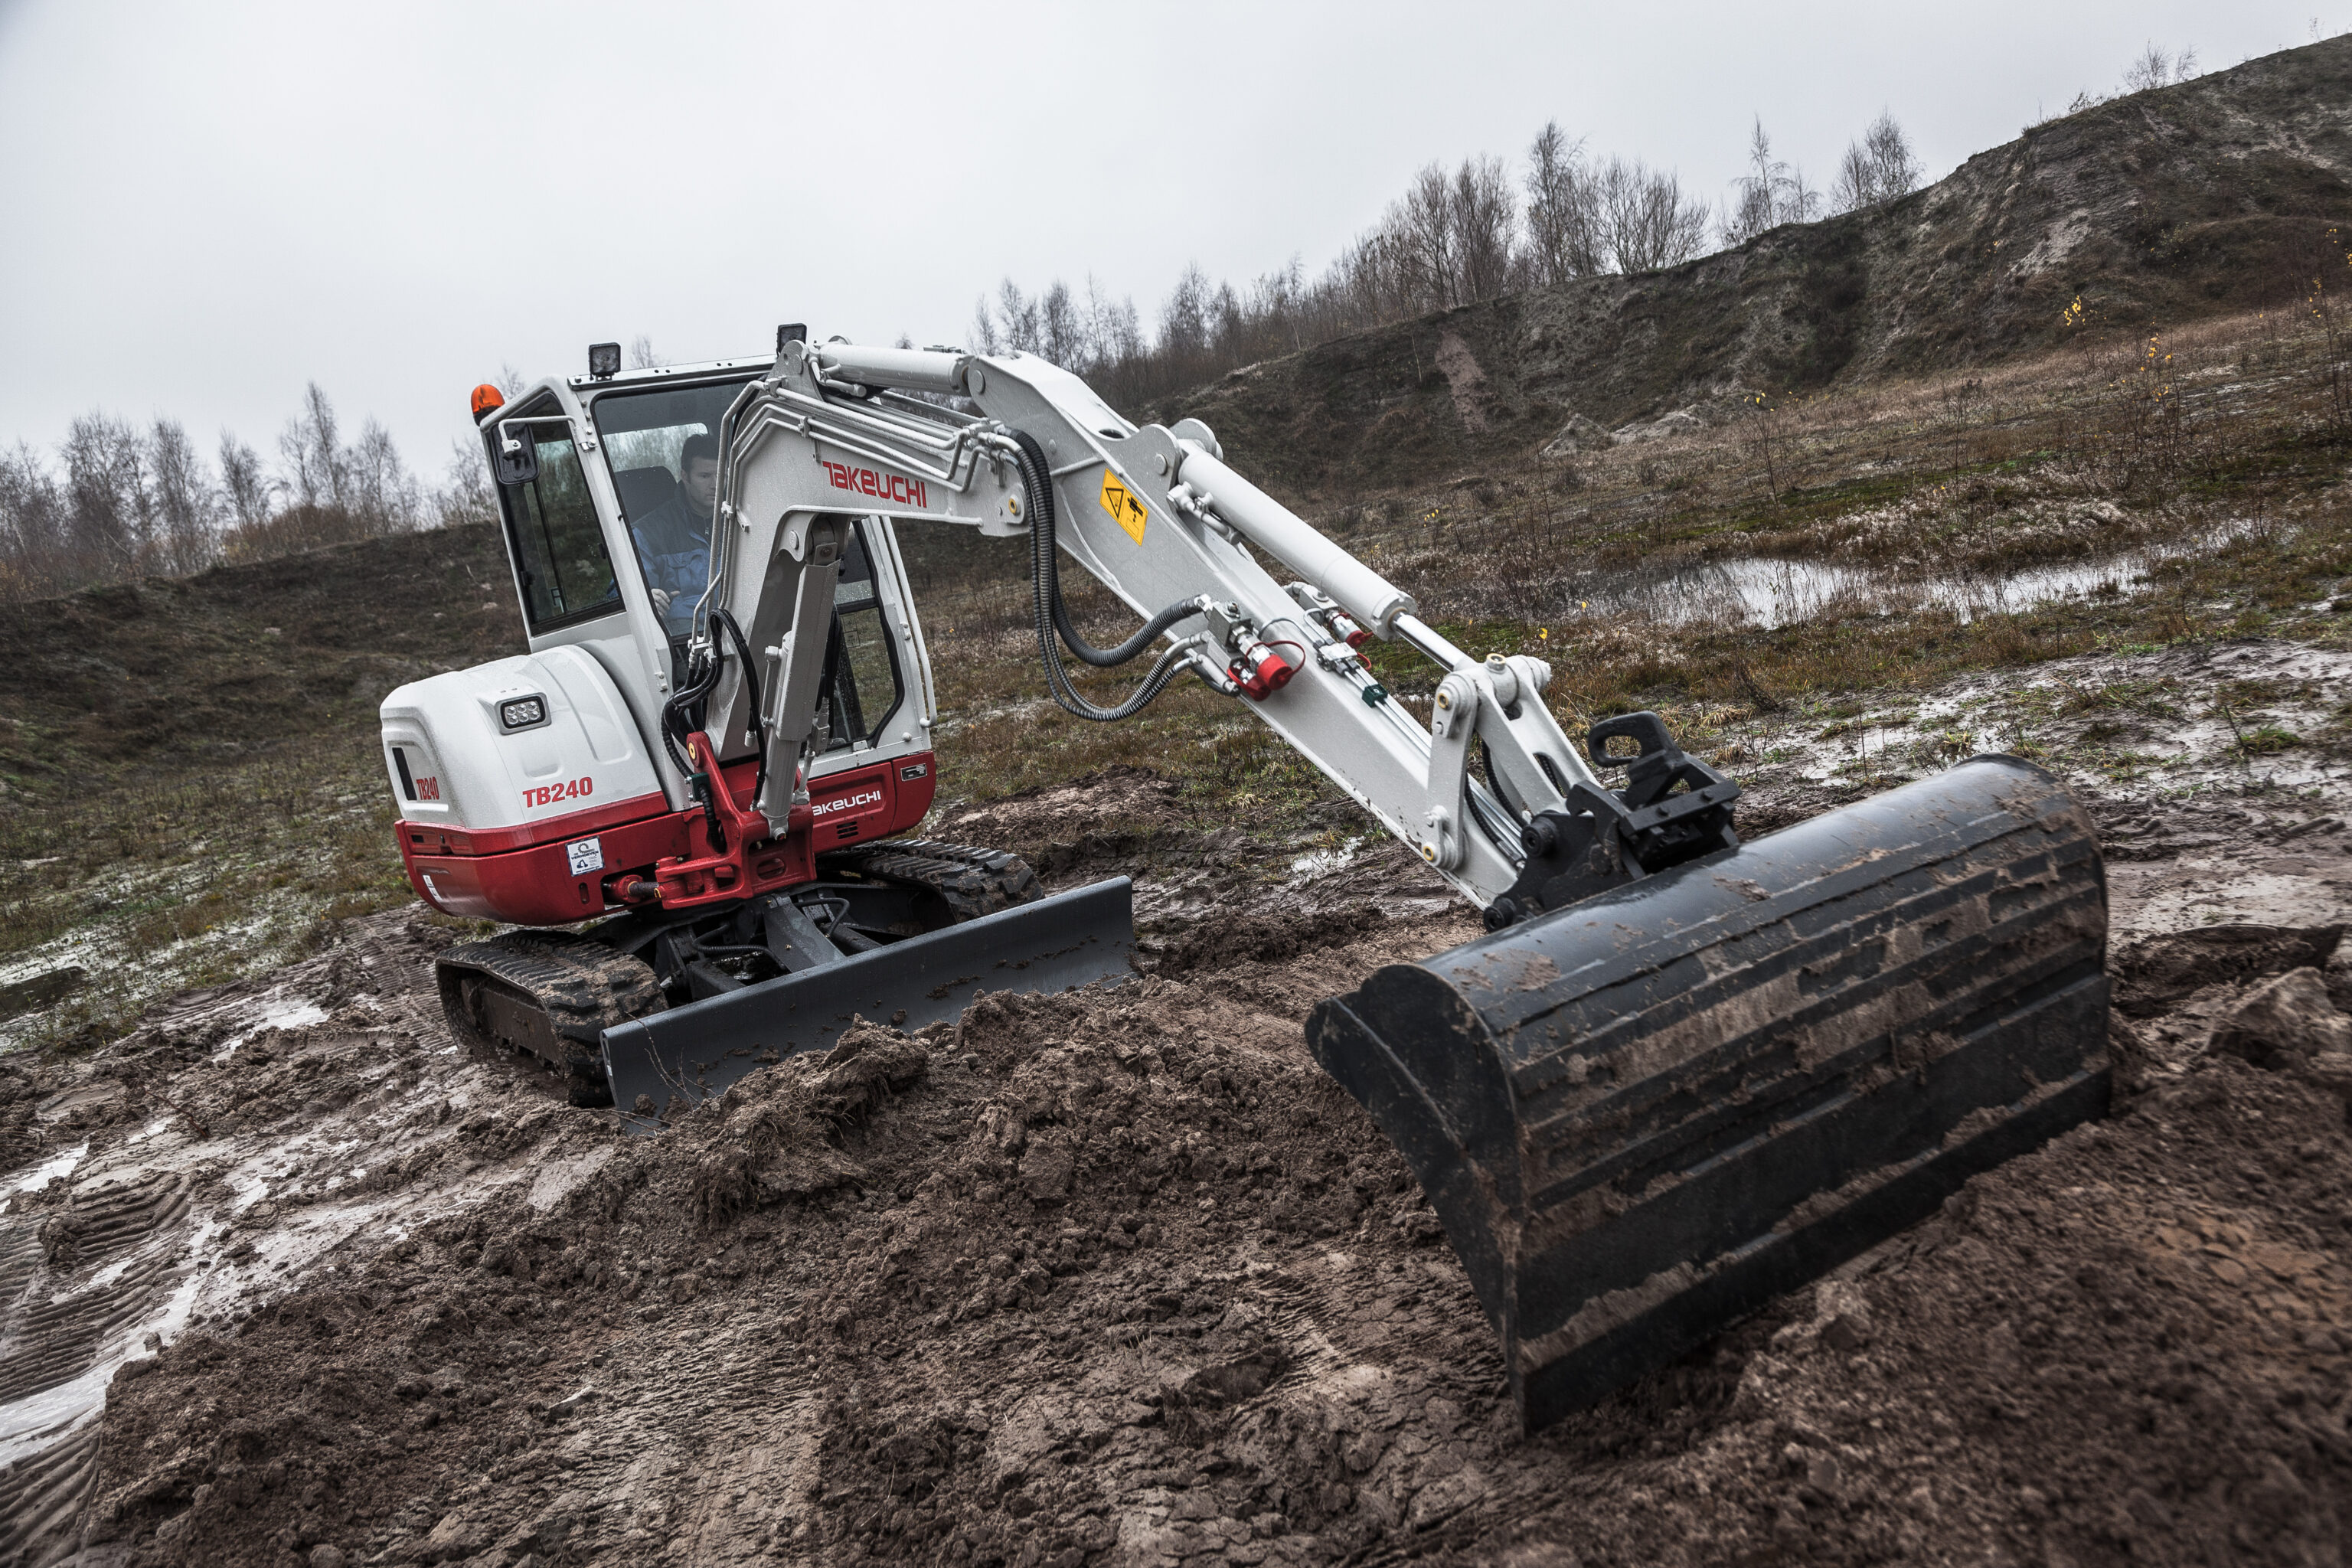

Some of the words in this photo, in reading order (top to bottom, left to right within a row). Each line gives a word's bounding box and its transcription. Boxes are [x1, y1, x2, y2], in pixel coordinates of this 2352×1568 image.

[416, 776, 439, 800] TB240
[521, 776, 593, 808] TB240
[812, 790, 881, 816] AKEUCHI
